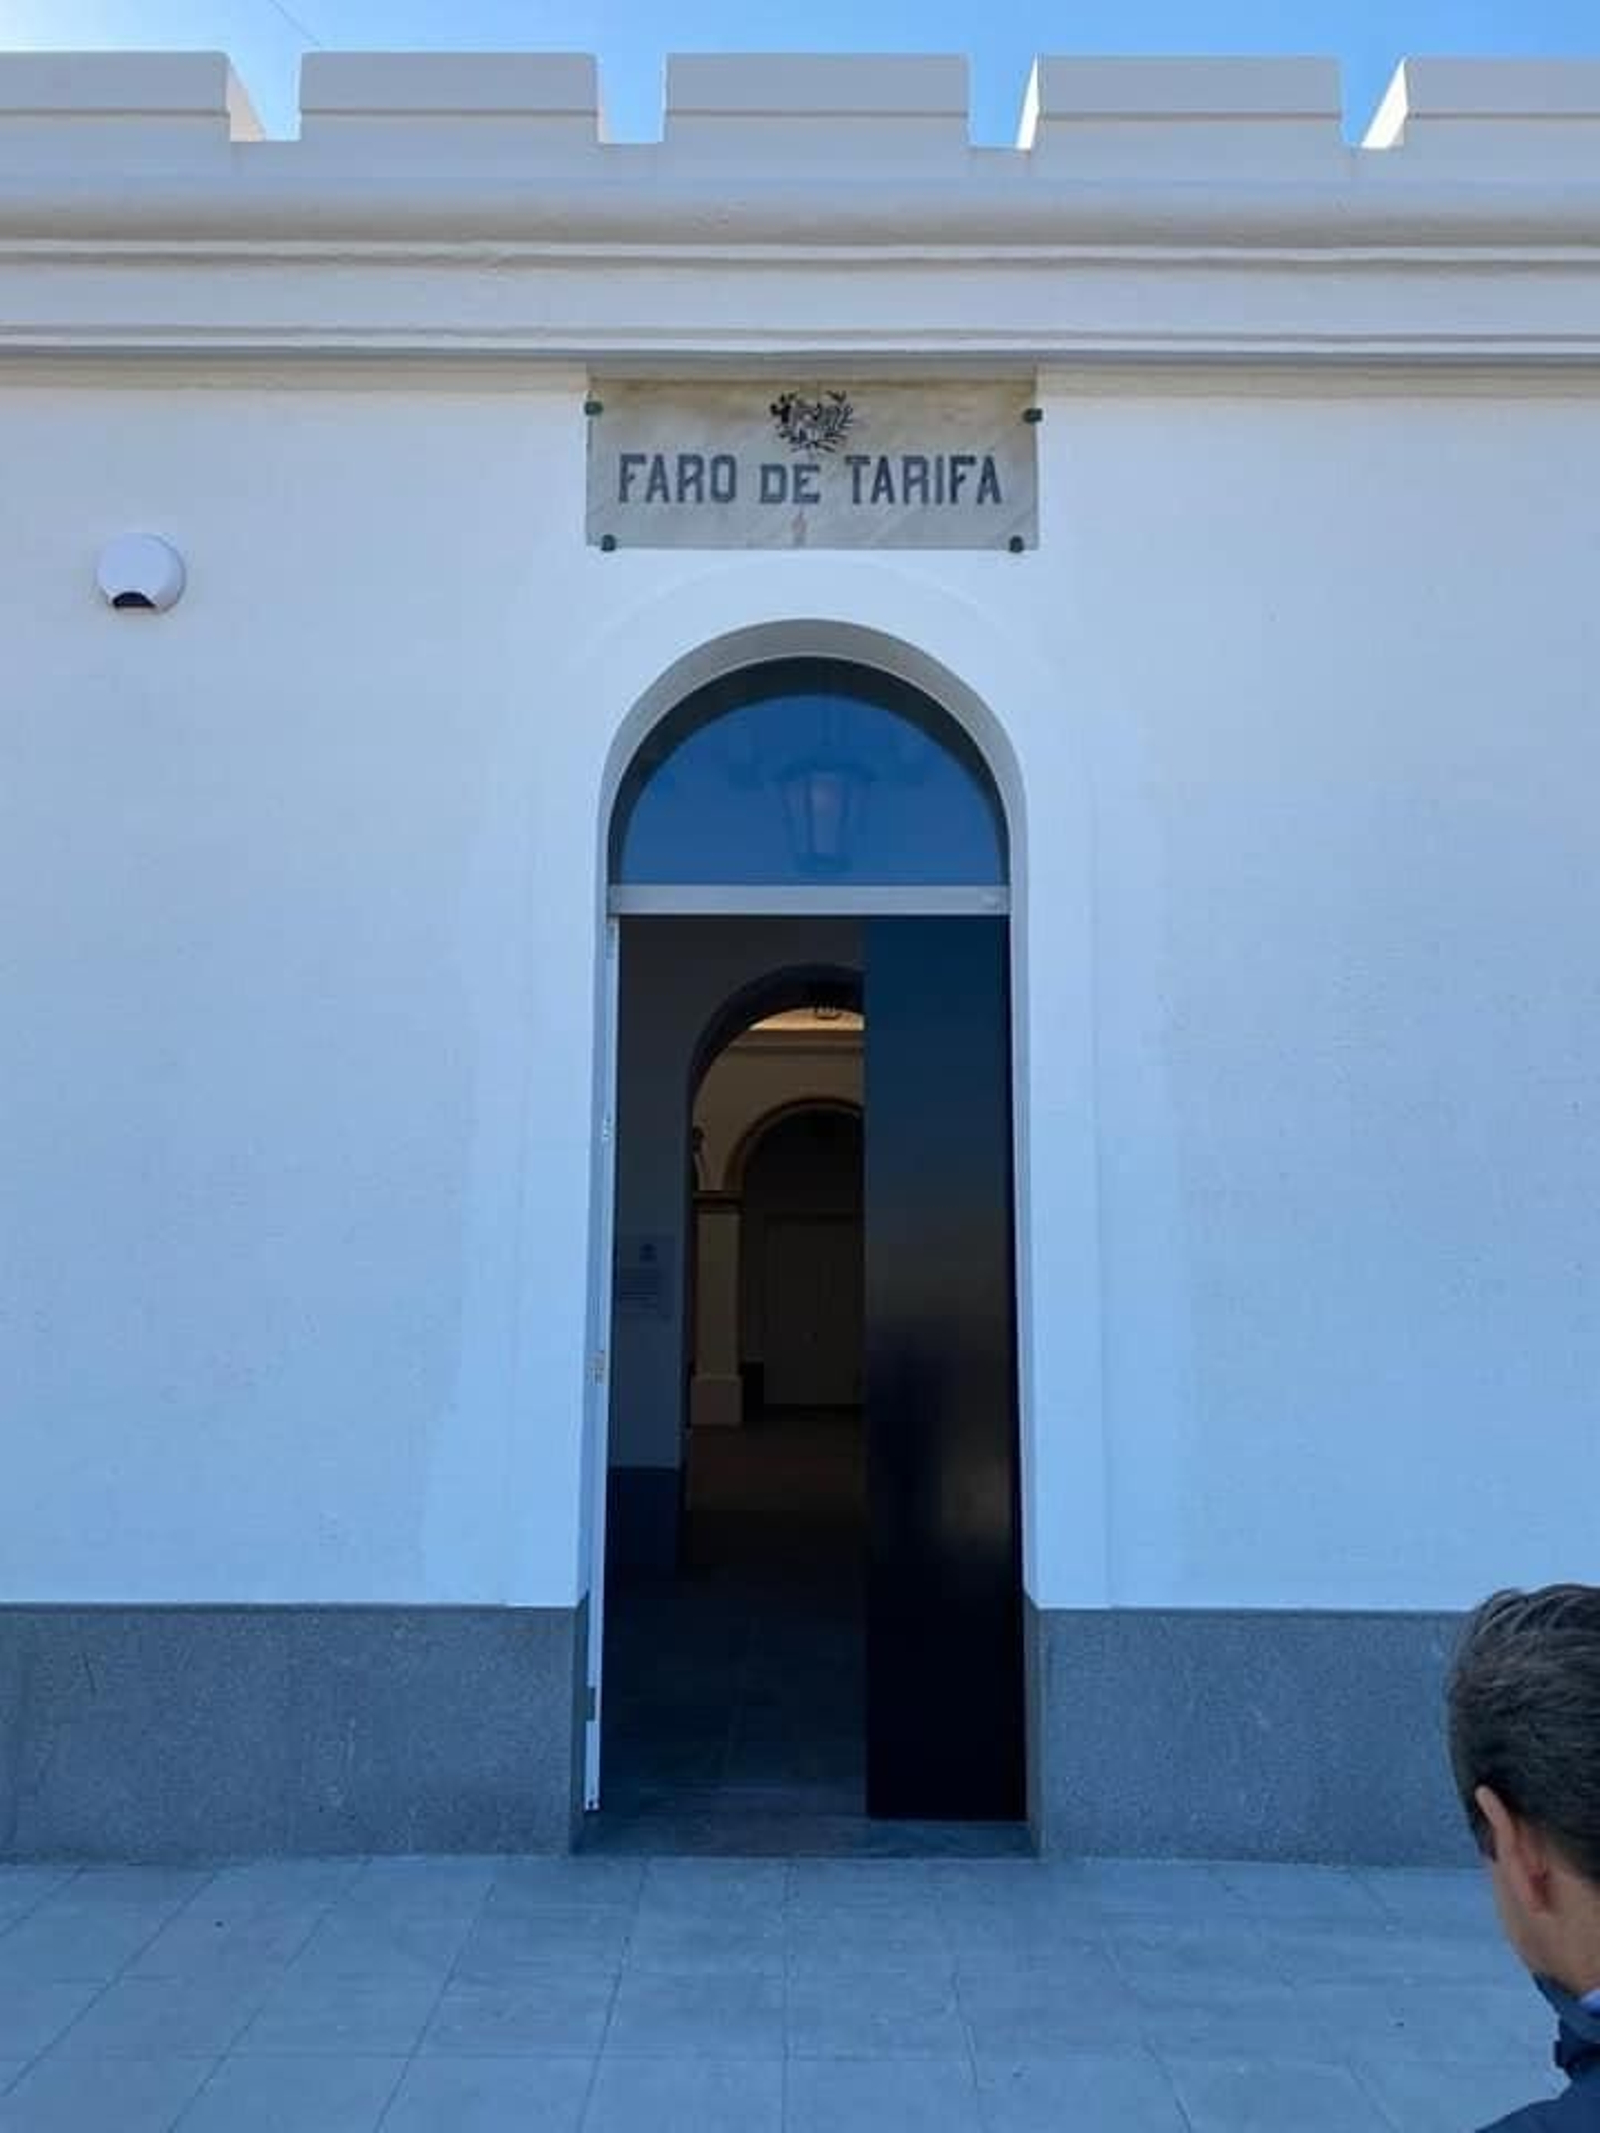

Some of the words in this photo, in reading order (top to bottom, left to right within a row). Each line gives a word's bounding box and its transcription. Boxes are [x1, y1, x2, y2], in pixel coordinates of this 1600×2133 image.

[618, 453, 738, 503] FARO
[759, 463, 821, 504] DE
[845, 455, 1003, 505] TARIFA
